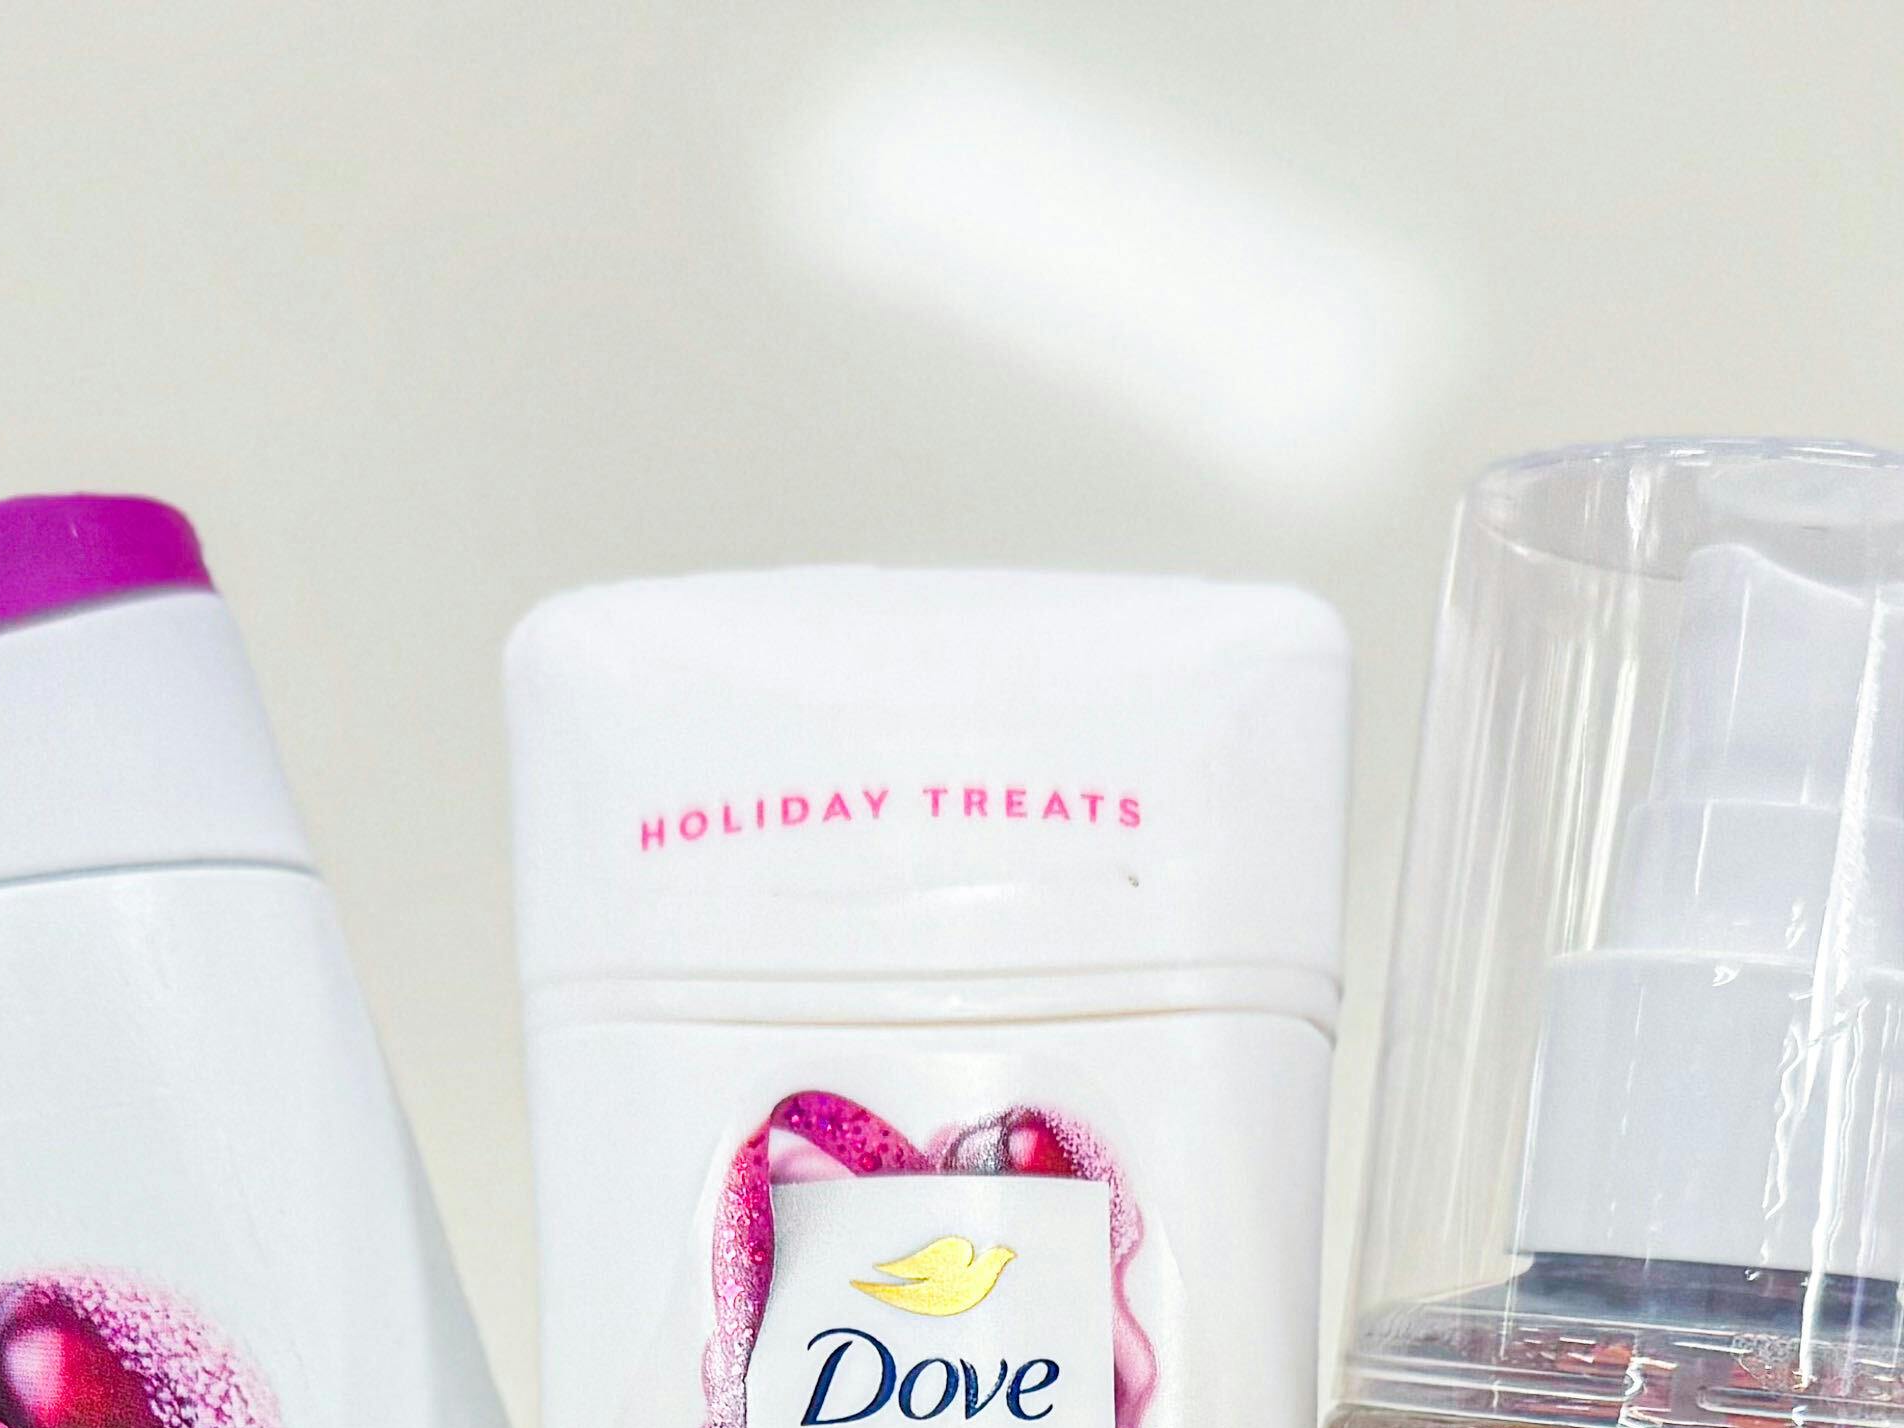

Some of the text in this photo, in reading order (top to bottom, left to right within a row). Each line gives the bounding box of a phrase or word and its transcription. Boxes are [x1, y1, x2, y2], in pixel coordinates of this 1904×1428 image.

[640, 787, 1142, 851] HOLIDAY TREATS
[799, 1327, 1061, 1427] Dove
